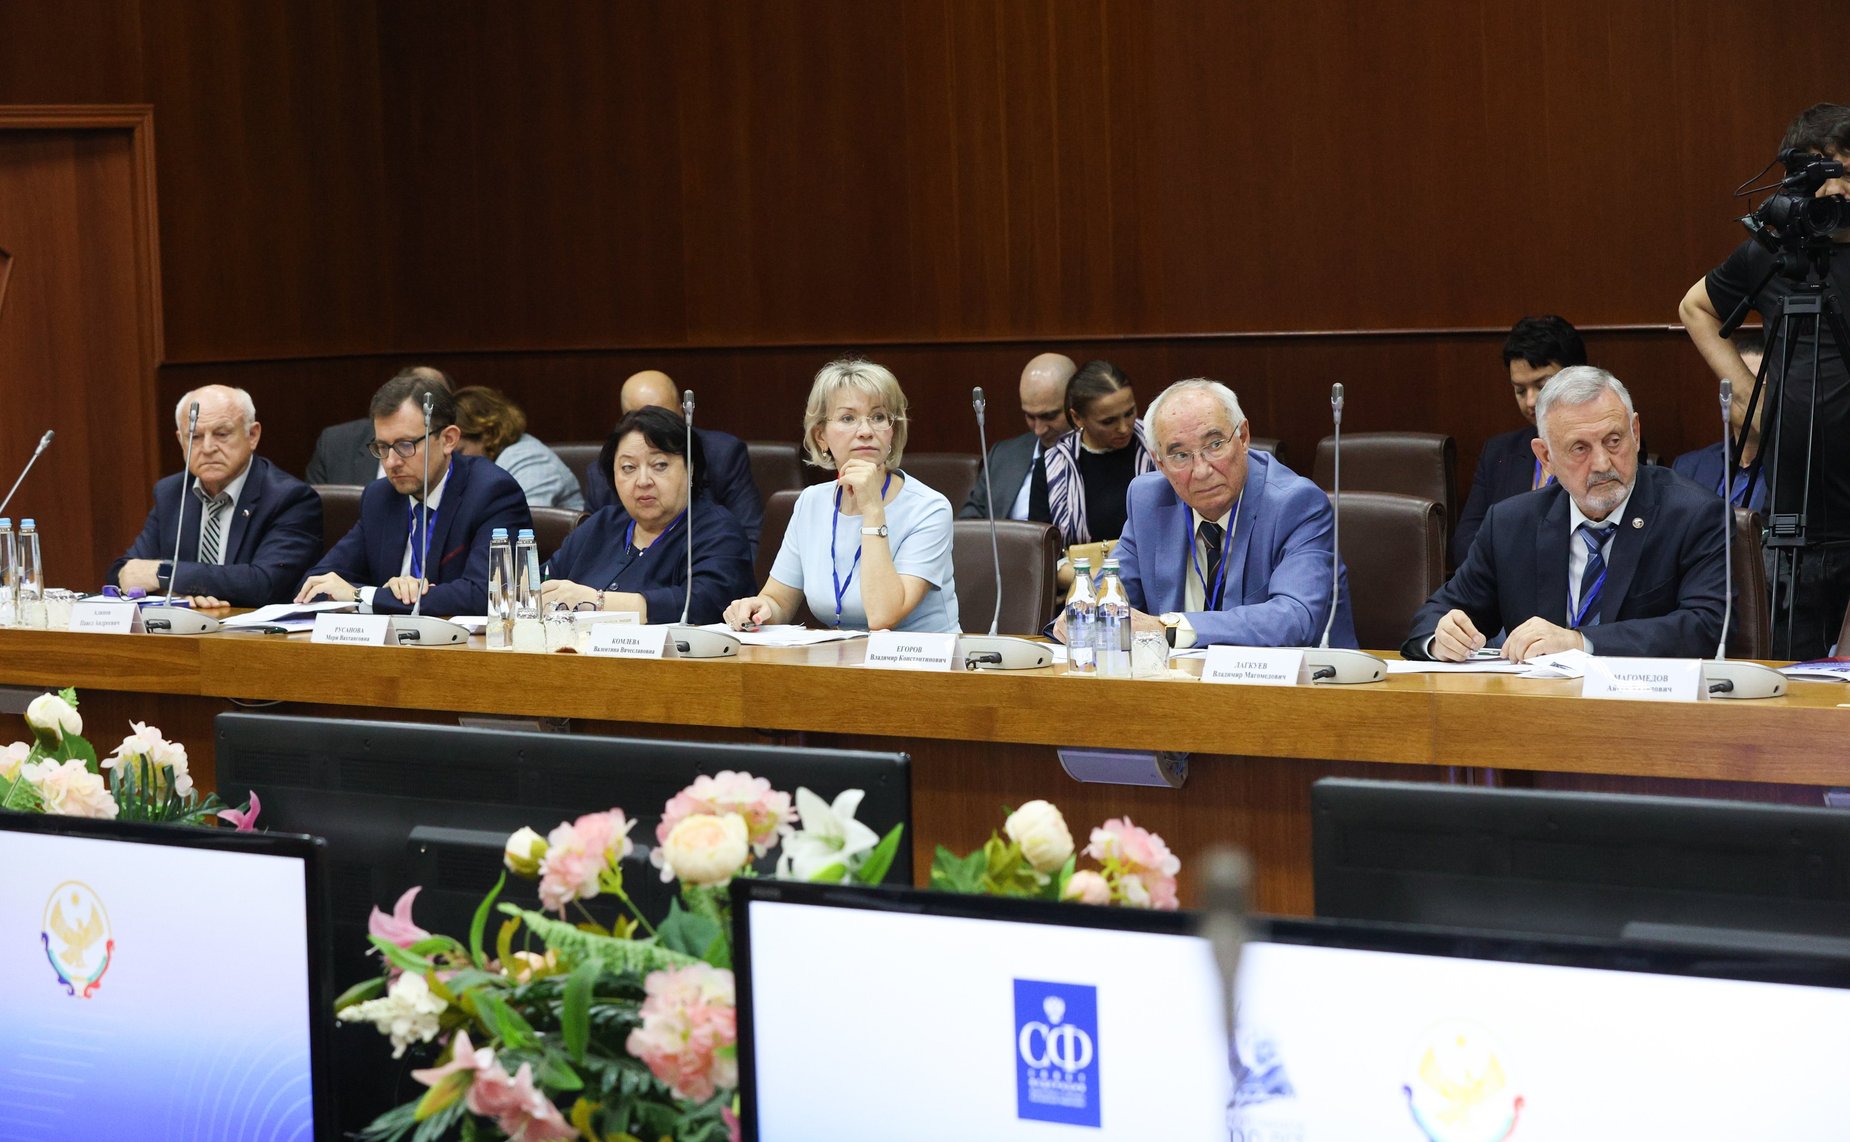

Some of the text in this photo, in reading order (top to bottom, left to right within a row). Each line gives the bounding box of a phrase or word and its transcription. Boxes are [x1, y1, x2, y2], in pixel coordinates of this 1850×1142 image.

[334, 626, 364, 634] РУСАНОВА
[593, 646, 620, 654] Валентина
[896, 645, 923, 653] ЕГОРОВ
[870, 654, 947, 663] Владимир Константинович
[1234, 661, 1268, 669] ЛАГКУЕВ
[1212, 670, 1287, 680] Владимир Магомедович
[1613, 674, 1669, 682] МАГОМЕДОВ
[1018, 1020, 1094, 1073] СФ
